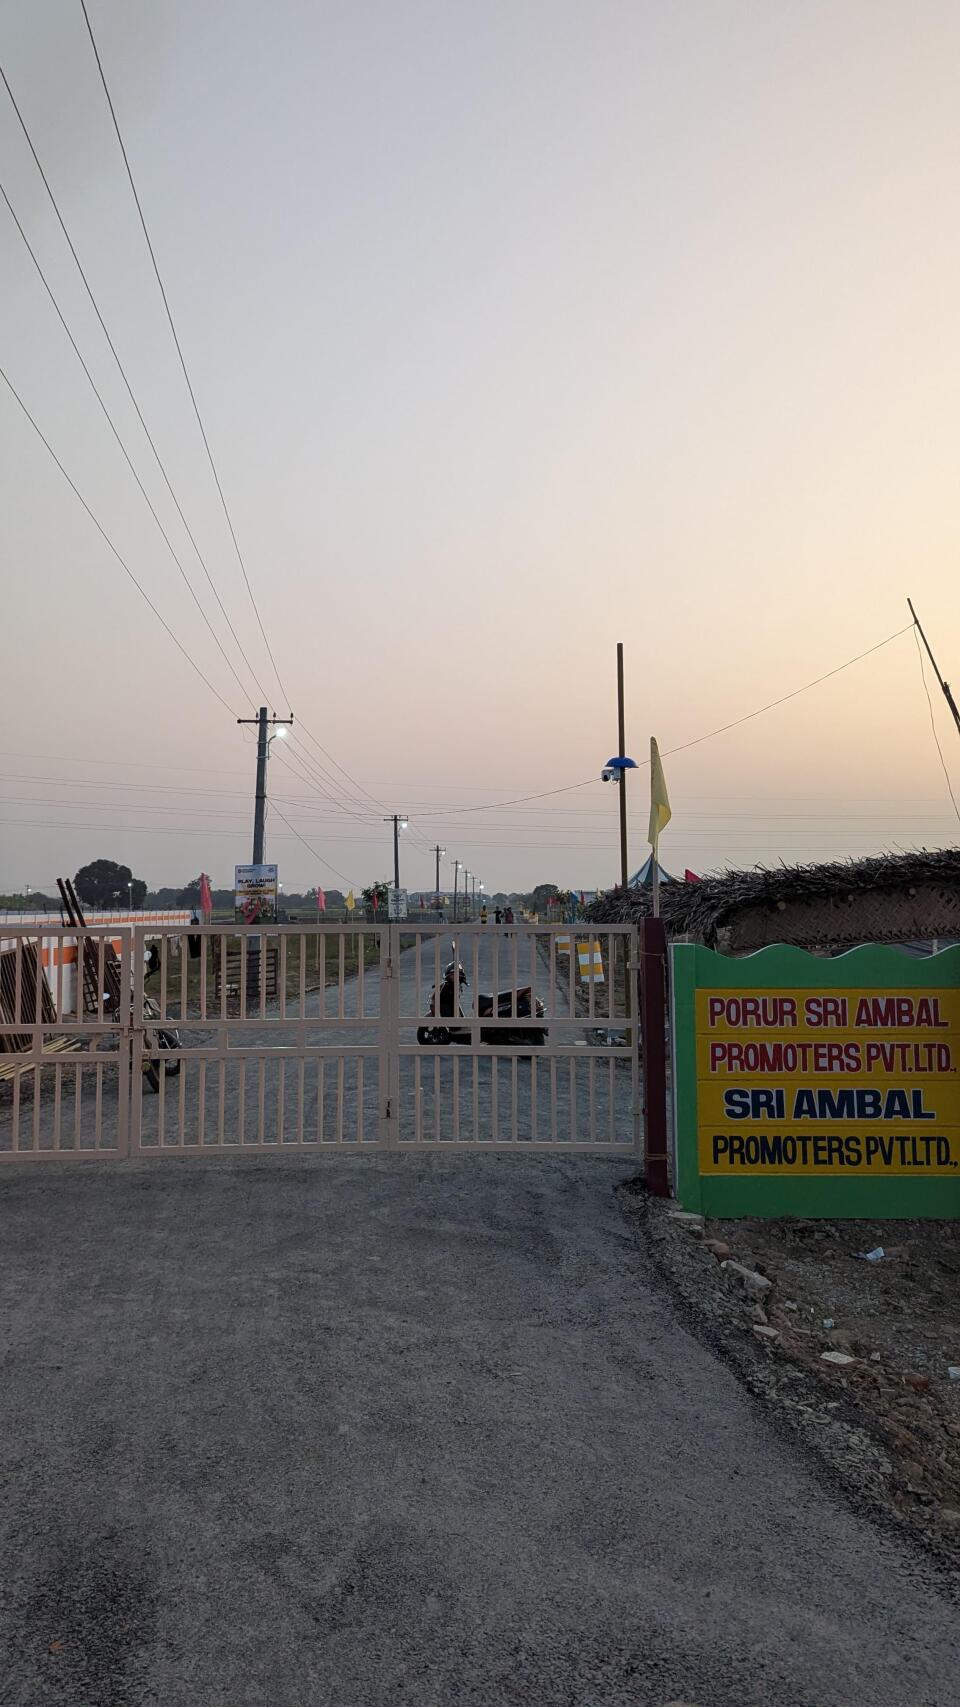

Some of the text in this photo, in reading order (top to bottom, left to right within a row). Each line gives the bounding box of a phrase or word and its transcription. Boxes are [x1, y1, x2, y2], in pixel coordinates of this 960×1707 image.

[708, 997, 949, 1028] PORUR SRI AMBAL
[710, 1042, 862, 1073] PROMOTERS
[723, 1088, 936, 1121] SRI AMBAL
[712, 1135, 862, 1166] PROMOTERS
